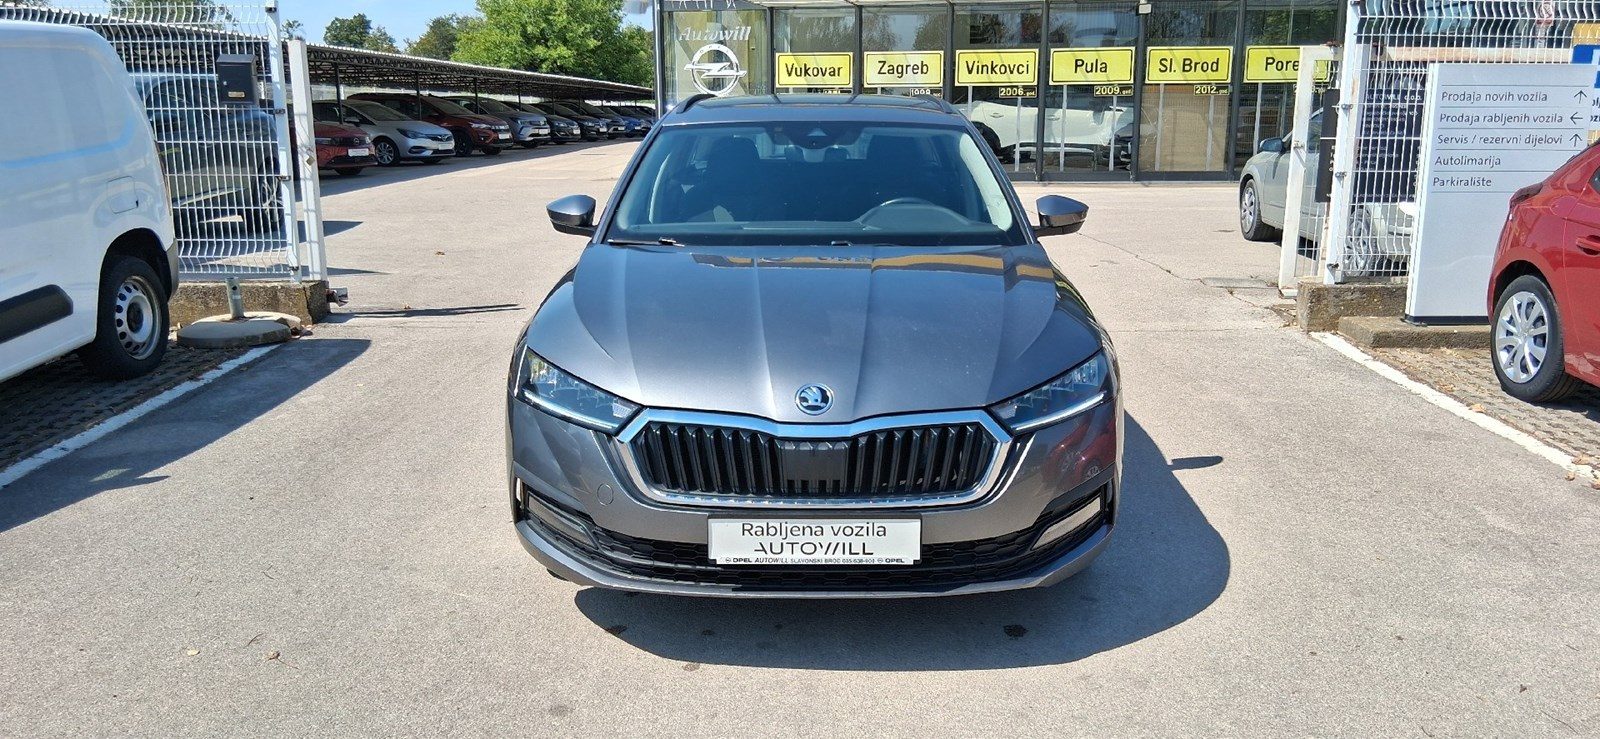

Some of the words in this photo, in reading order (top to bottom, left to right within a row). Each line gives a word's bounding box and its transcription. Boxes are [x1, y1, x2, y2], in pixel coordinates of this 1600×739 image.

[679, 26, 751, 41] Autowill
[785, 63, 845, 77] Vukovar
[877, 61, 930, 78] Zagreb
[966, 60, 1030, 75] Vinkovci
[1074, 59, 1108, 74] Pula
[1158, 58, 1177, 73] Sl.
[1182, 57, 1220, 73] Brod
[1000, 87, 1025, 96] 2006.
[1095, 86, 1121, 95] 2009.
[1195, 85, 1218, 95] 2012.
[1441, 92, 1481, 104] Prodaja
[1485, 92, 1515, 102] novih
[1517, 92, 1548, 102] vozila
[1440, 113, 1480, 126] Prodaja
[1483, 113, 1530, 125] rabljenih
[1532, 113, 1563, 124] vozila
[1438, 135, 1469, 145] Servis
[1479, 135, 1522, 145] rezervni
[1524, 134, 1563, 147] dijelovi
[1435, 156, 1501, 168] Autolimarija
[1433, 176, 1492, 188] Parkiralište
[741, 522, 824, 539] Rabljena
[831, 522, 887, 536] vozila
[754, 542, 874, 555] AUTOWILL
